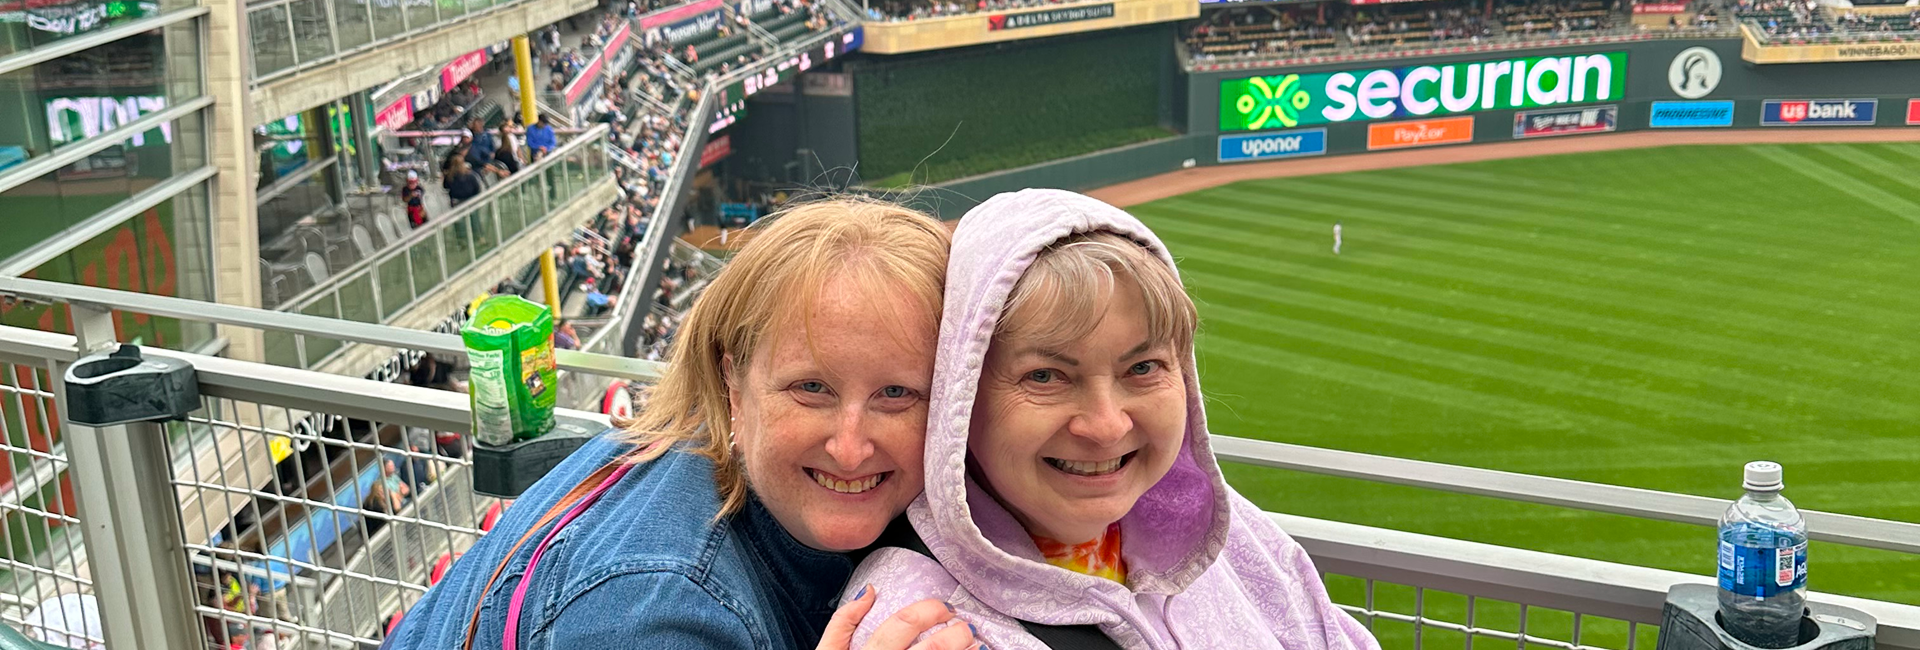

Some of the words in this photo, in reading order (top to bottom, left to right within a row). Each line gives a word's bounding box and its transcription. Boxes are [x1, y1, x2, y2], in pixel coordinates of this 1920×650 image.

[1016, 13, 1050, 26] DELTA
[1838, 45, 1907, 57] WINNEBAGO
[1322, 53, 1612, 121] securian
[1653, 107, 1729, 121] PROGRESSIVE
[1394, 124, 1447, 145] Paycor
[1242, 136, 1303, 157] uponor
